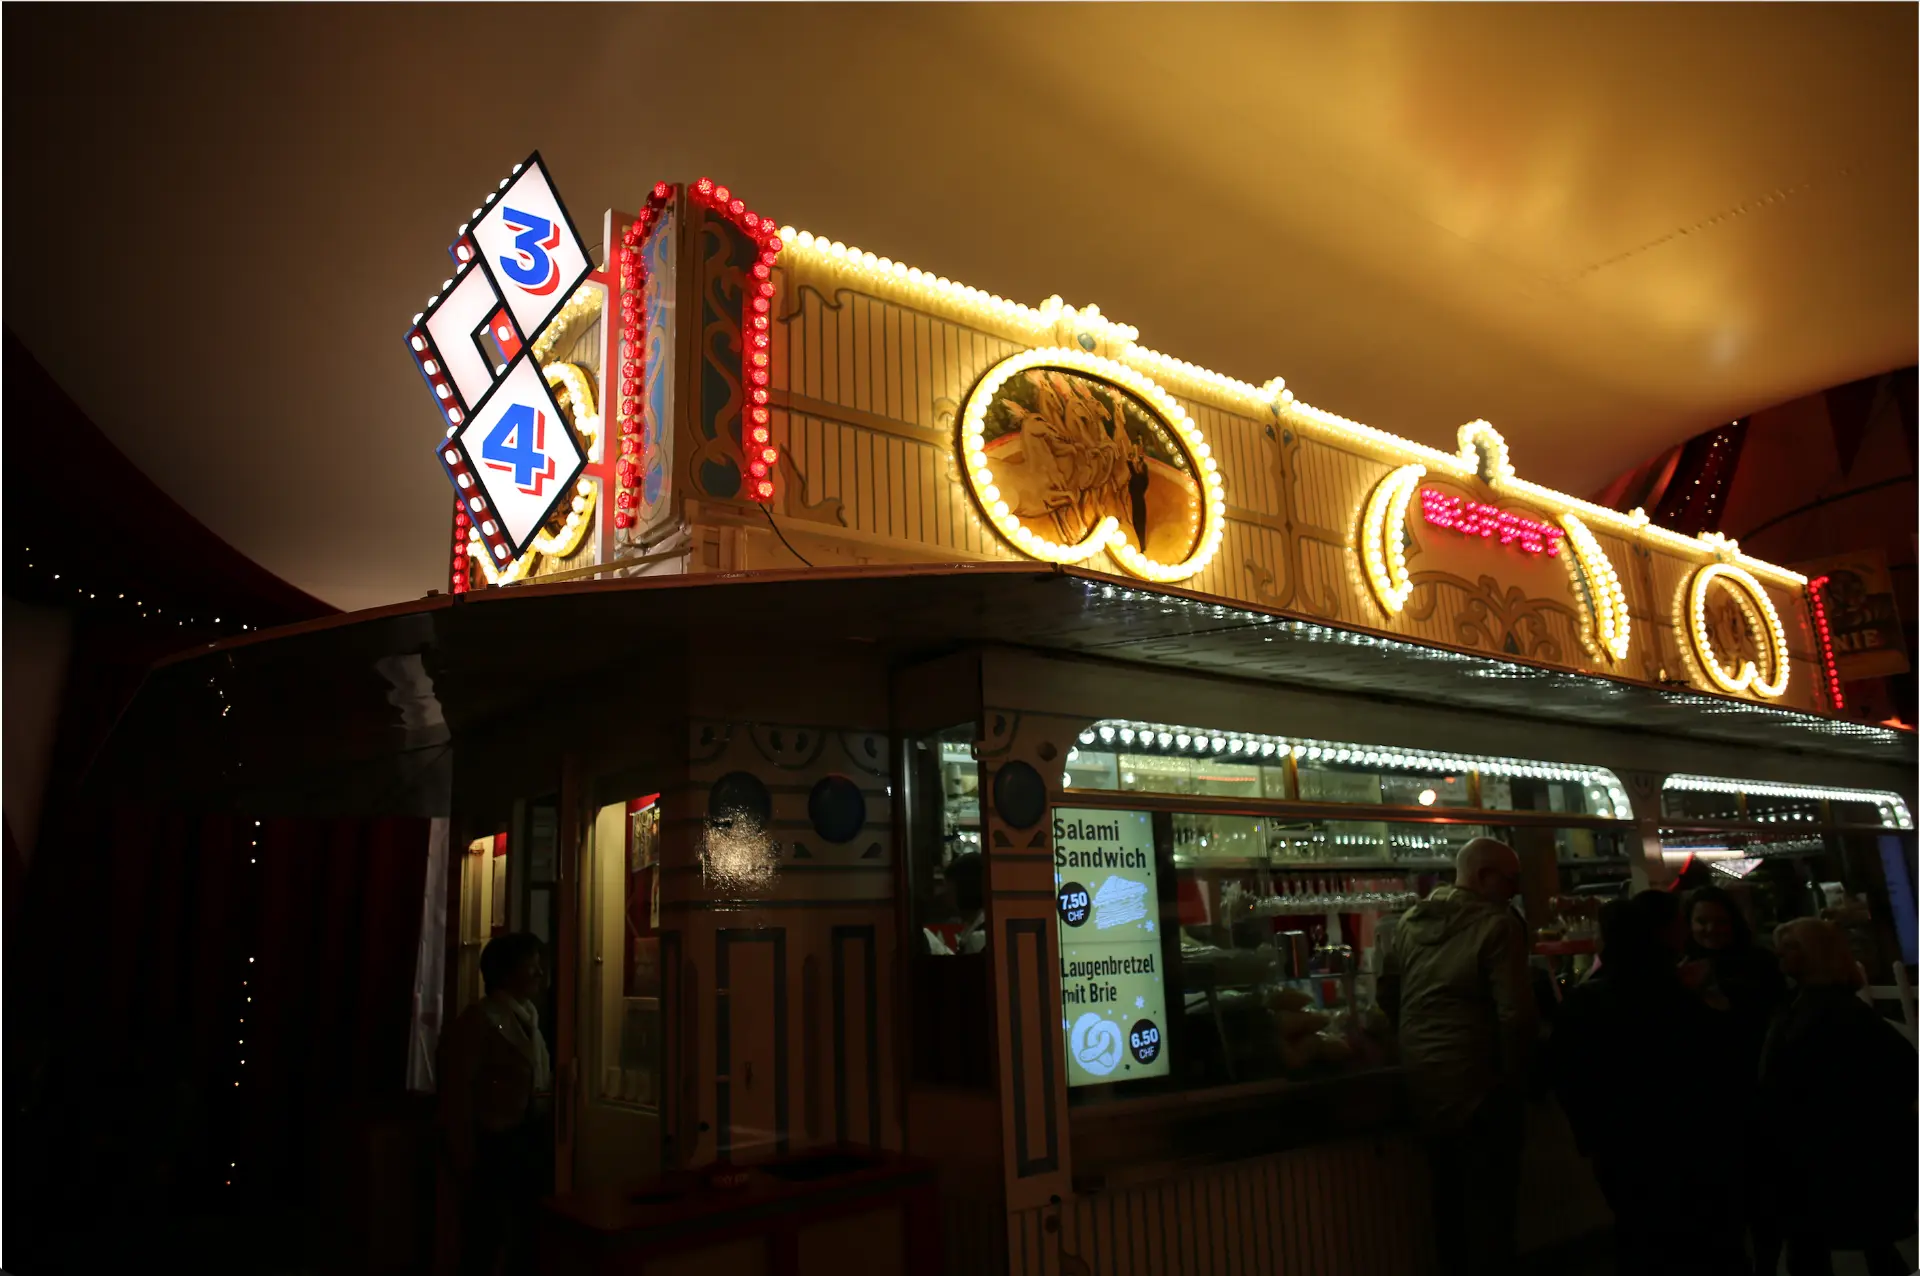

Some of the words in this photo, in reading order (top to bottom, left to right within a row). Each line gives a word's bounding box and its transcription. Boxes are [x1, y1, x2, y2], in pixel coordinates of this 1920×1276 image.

[500, 206, 559, 295] 3
[482, 404, 555, 496] 4
[1420, 487, 1566, 559] BUFFET
[1053, 818, 1120, 841] Salami
[1055, 846, 1147, 868] Sandwich
[1060, 892, 1088, 910] 7.50
[1067, 909, 1085, 922] CHF
[1061, 954, 1155, 980] Laugenbretzel
[1062, 983, 1086, 1004] mit
[1089, 982, 1117, 1003] Brie
[1131, 1028, 1159, 1048] 6.50
[1139, 1046, 1155, 1059] CHF
